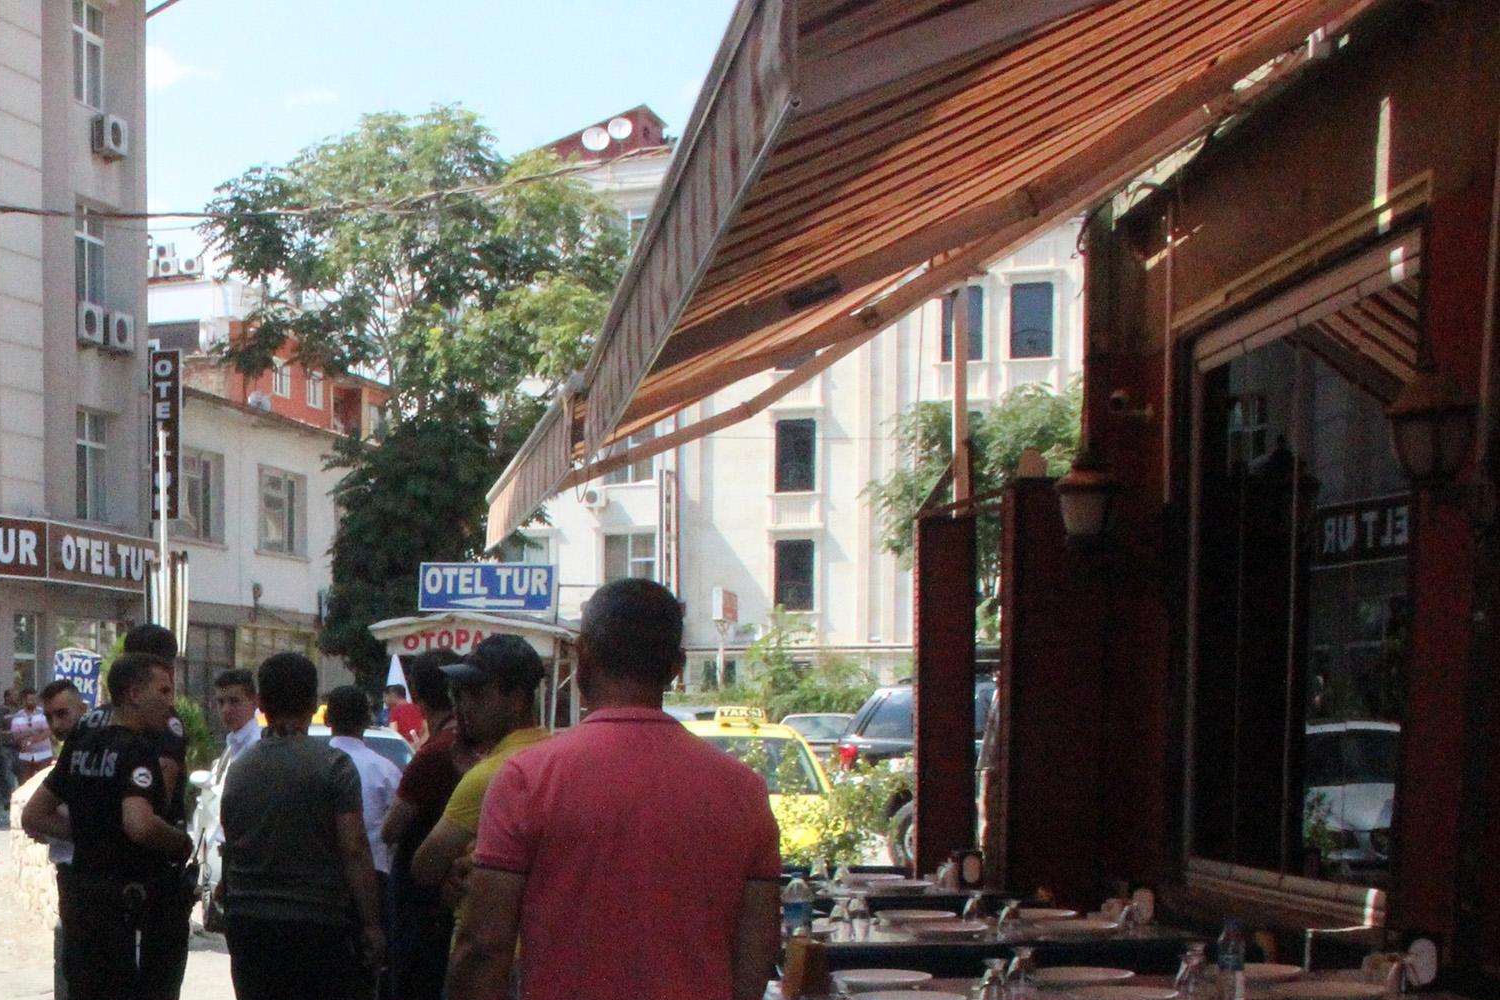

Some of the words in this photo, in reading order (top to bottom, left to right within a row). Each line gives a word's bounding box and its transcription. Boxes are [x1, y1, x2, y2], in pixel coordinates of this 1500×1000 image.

[61, 534, 116, 578] OTEL
[424, 567, 488, 596] OTEL
[496, 567, 548, 597] TUR
[403, 629, 485, 652] OTOPA
[62, 654, 93, 676] OTO
